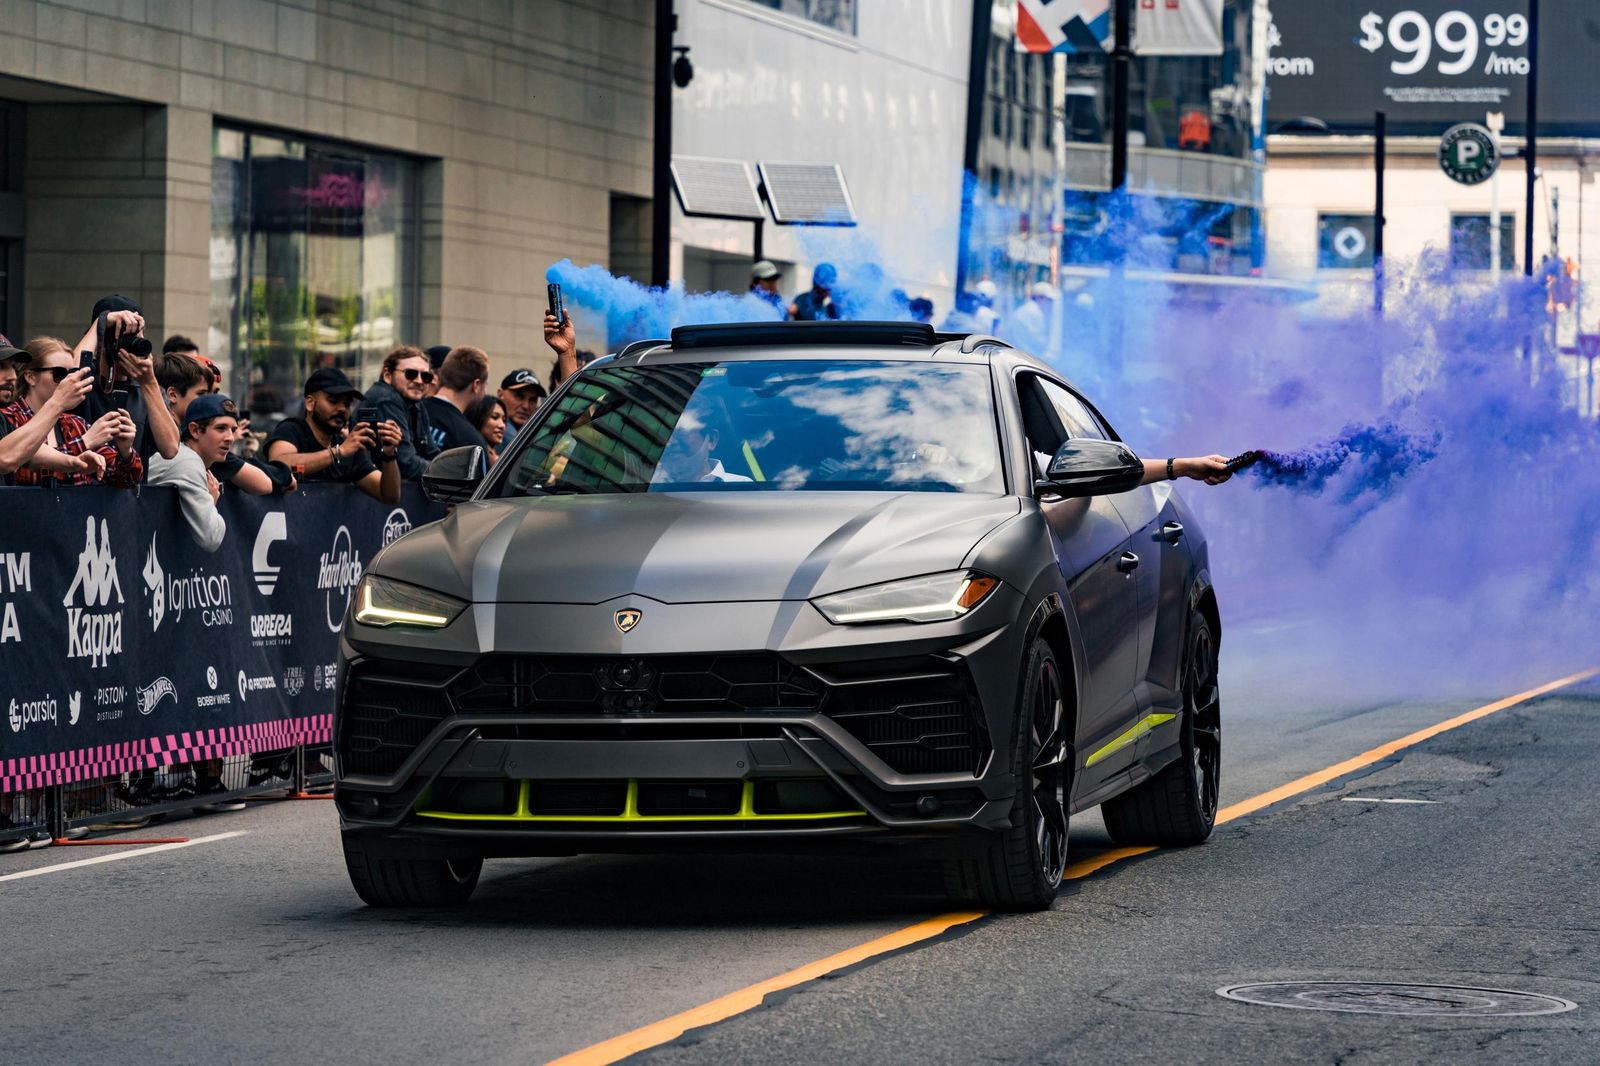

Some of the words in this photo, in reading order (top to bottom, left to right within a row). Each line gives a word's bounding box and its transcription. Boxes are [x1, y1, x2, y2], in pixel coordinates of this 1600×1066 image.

[1265, 57, 1314, 76] rom
[1485, 51, 1530, 75] /mo
[1457, 140, 1480, 165] P
[168, 568, 232, 623] Ignition
[202, 608, 233, 626] CASINO
[66, 608, 123, 668] Kappa
[97, 686, 125, 706] PISTON
[197, 695, 216, 707] BOBBY
[215, 693, 231, 705] WHITE
[22, 693, 57, 731] parsiq
[96, 710, 123, 721] DISTILLERY
